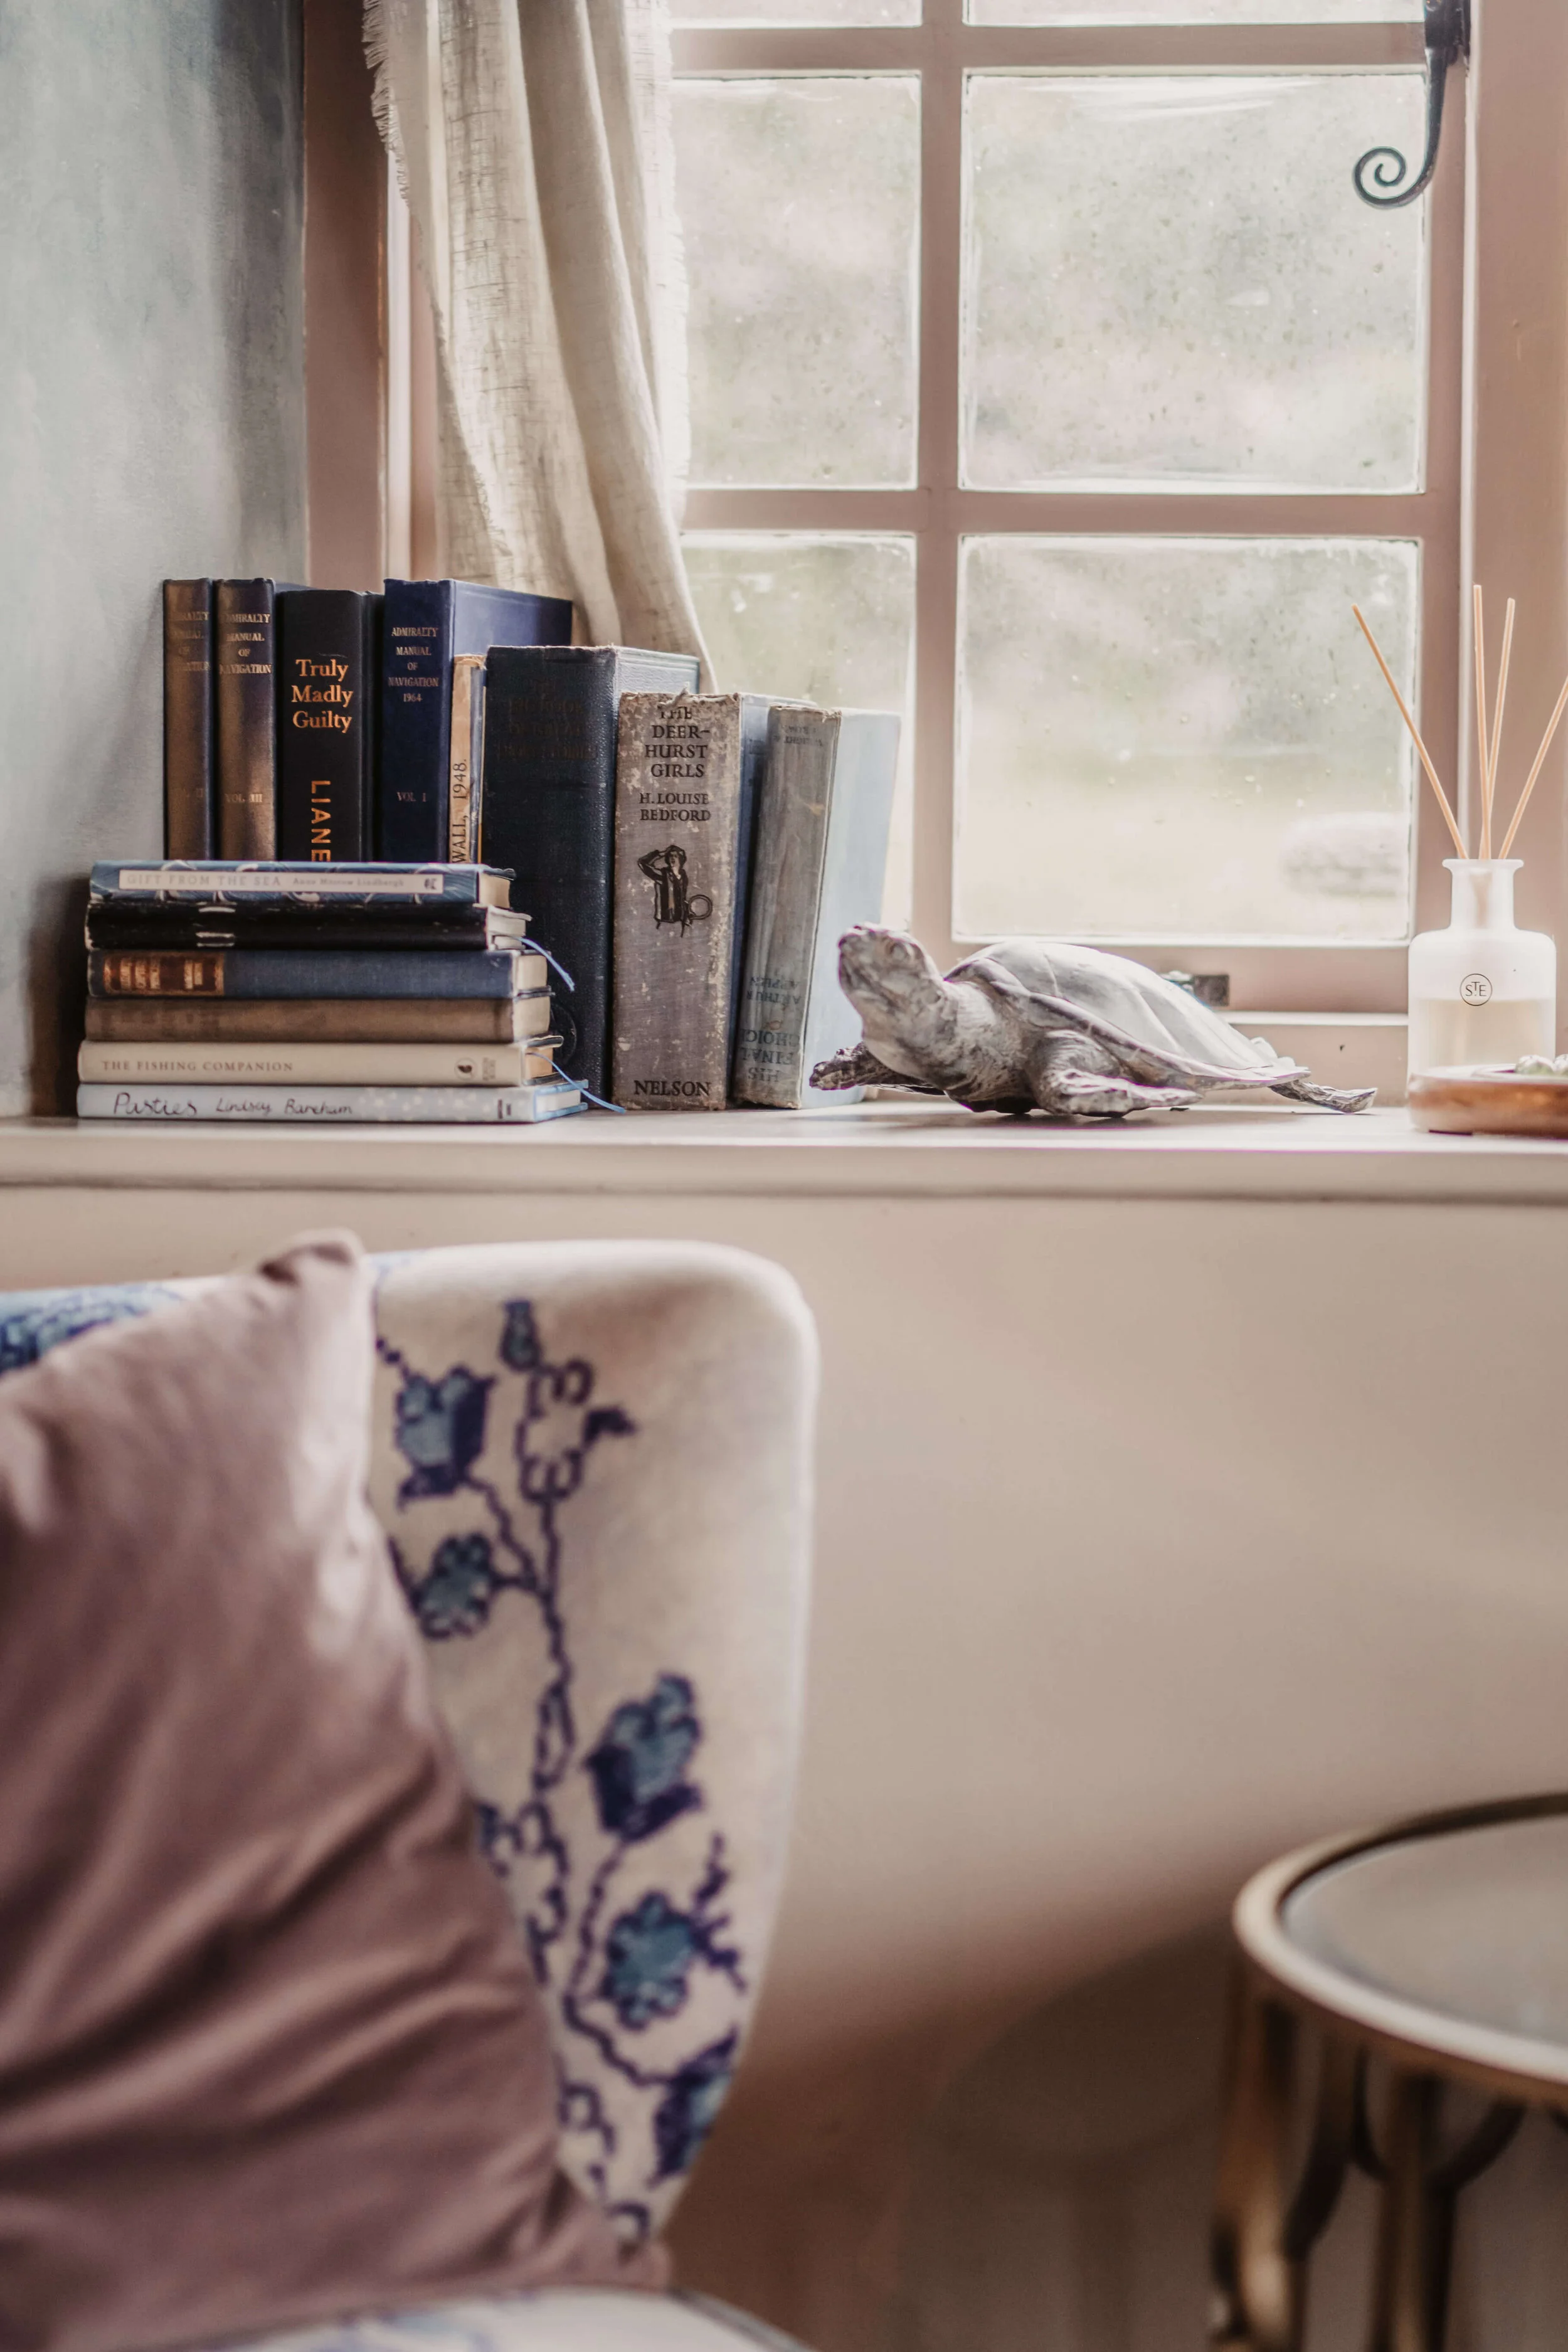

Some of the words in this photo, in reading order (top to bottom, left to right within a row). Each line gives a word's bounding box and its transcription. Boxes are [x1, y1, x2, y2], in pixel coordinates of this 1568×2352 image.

[221, 613, 270, 623] DMIRALTY
[226, 632, 265, 642] MANUAL
[391, 627, 438, 637] ADMIRALTY
[238, 649, 251, 657] OF
[396, 646, 432, 655] MANUAL
[295, 659, 349, 682] Truly
[407, 662, 418, 670] OF
[388, 677, 439, 687] NAVIGATION
[292, 685, 353, 707] Madly
[403, 693, 422, 702] 1964
[657, 706, 692, 719] THE
[293, 711, 352, 733] Guilty
[652, 725, 710, 739] DEER-
[645, 744, 708, 758] HURST
[651, 763, 704, 778] GIRLS
[452, 759, 467, 800] 1948.
[311, 780, 331, 862] LIANE
[640, 809, 711, 821] BEDFORD
[126, 874, 162, 884] GIFT
[169, 875, 209, 885] FROM
[218, 876, 247, 886] THE
[253, 876, 281, 886] SEA
[102, 1061, 130, 1071] THE
[137, 1061, 197, 1071] FISHING
[203, 1061, 293, 1072] COMPANION
[634, 1080, 711, 1096] NELSON
